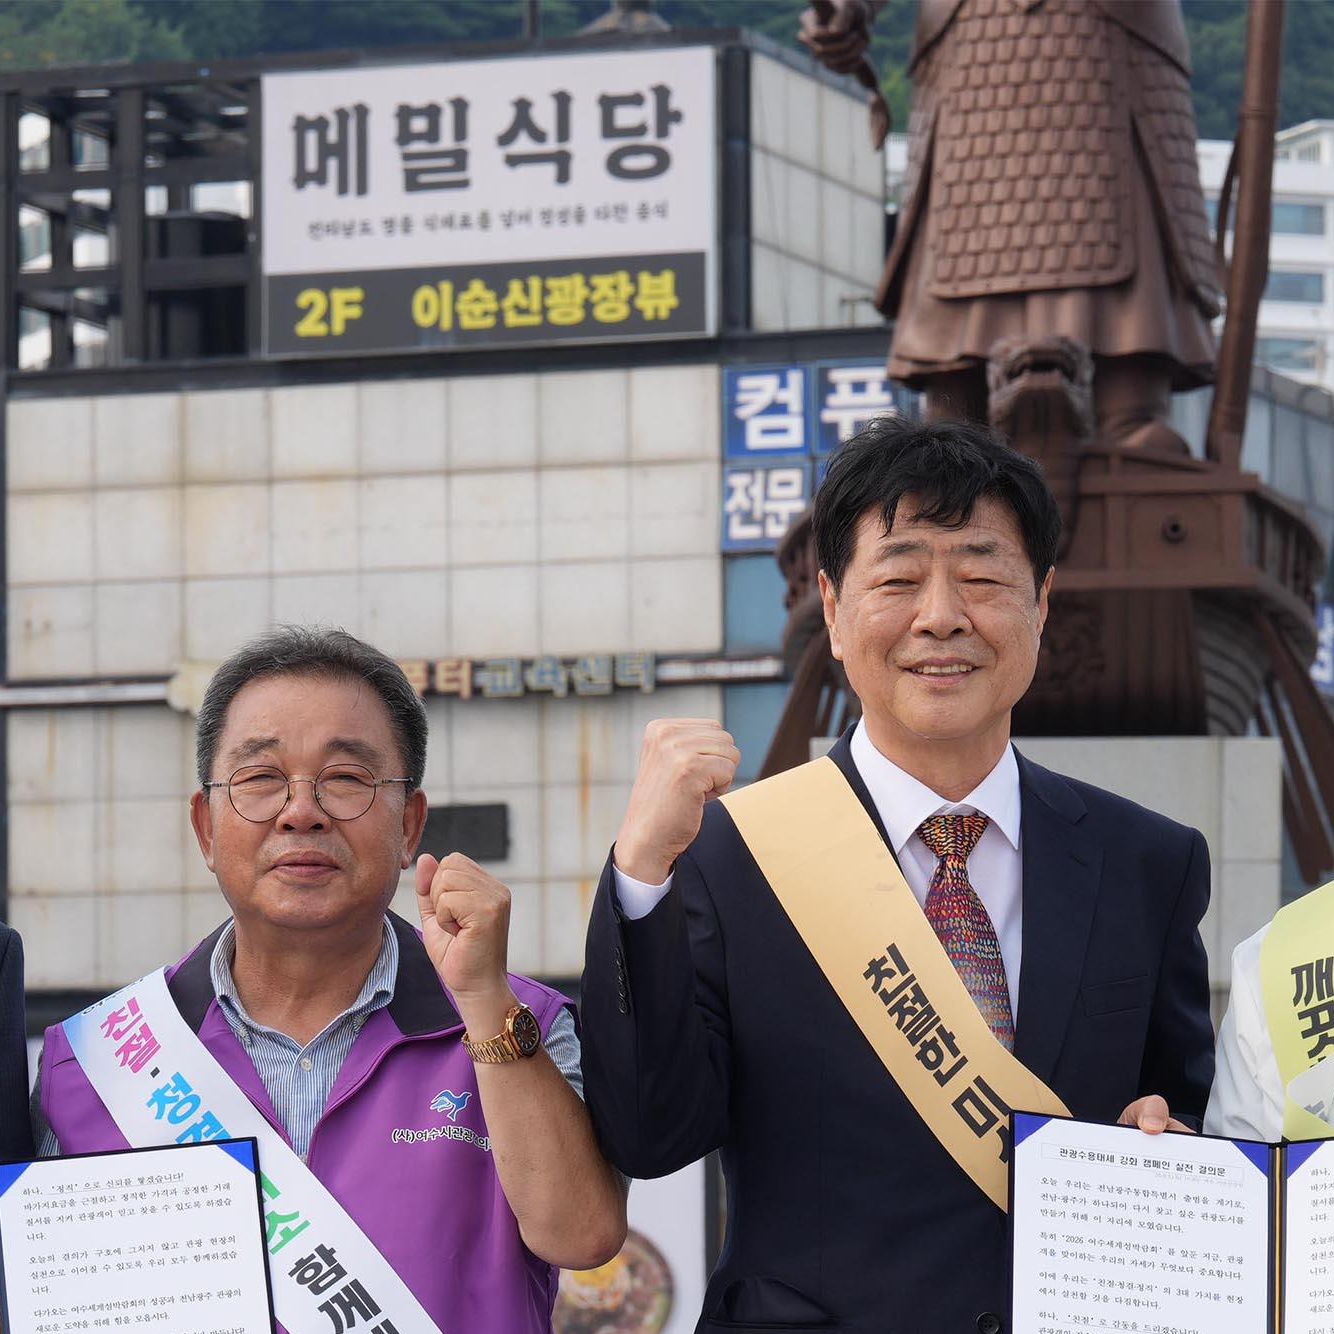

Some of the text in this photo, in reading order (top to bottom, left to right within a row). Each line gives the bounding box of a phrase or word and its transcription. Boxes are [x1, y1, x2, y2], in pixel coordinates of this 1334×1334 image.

[292, 83, 684, 196] 메밀식당
[294, 269, 679, 337] 2F 이순신광장뷰
[861, 942, 969, 1087] 친절한
[1059, 1148, 1225, 1176] 관광수용태세 강화 캠페인 실천 결의문
[1040, 1176, 1058, 1186] 오늘
[1064, 1179, 1091, 1190] 우리는
[1097, 1183, 1177, 1200] 전남광주통합특별시
[1182, 1194, 1210, 1204] 출범을
[1091, 1198, 1127, 1209] 하나되어
[1132, 1203, 1150, 1212] 다시
[1155, 1206, 1173, 1216] 찾고
[1177, 1209, 1196, 1219] 싶은
[1200, 1212, 1244, 1224] 관광도시를
